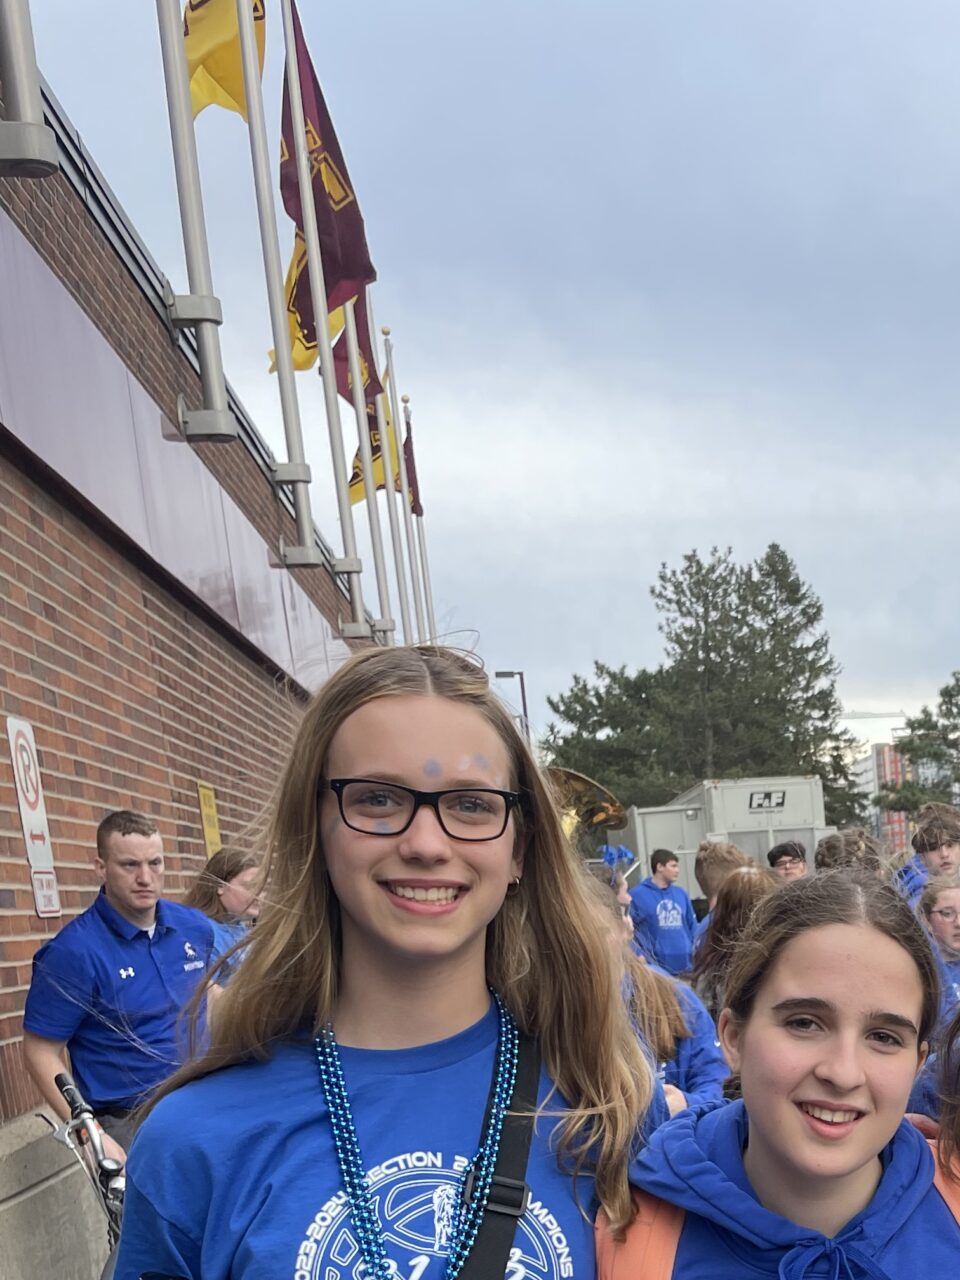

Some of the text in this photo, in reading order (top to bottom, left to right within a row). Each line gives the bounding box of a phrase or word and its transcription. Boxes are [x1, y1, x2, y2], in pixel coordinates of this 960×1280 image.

[752, 792, 784, 808] F&F
[453, 1155, 469, 1172] 2
[526, 1191, 574, 1278] MPIONS
